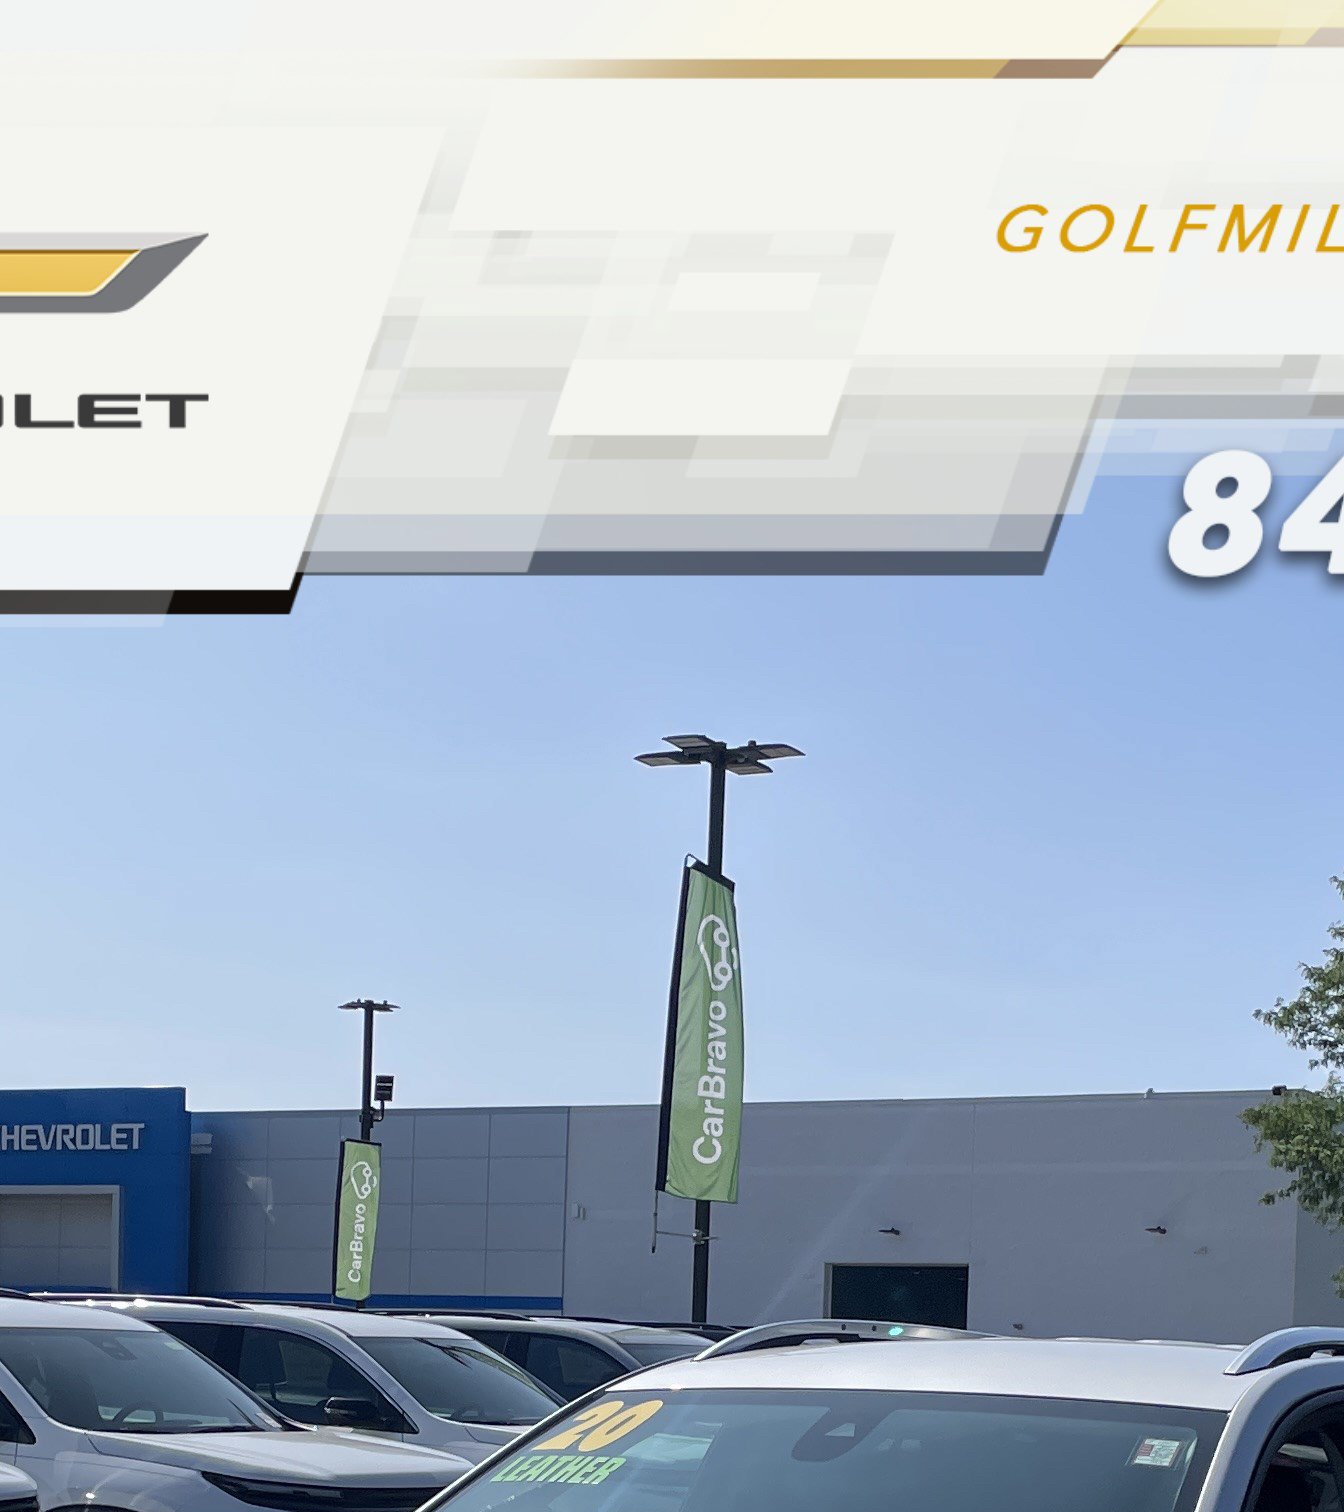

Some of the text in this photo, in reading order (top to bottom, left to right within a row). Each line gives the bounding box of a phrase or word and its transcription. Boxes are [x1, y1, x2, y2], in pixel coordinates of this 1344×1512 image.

[692, 1000, 728, 1164] CarBravo
[347, 1203, 367, 1283] CarBravo
[530, 1400, 665, 1452] 20
[490, 1455, 627, 1485] LEATHER
